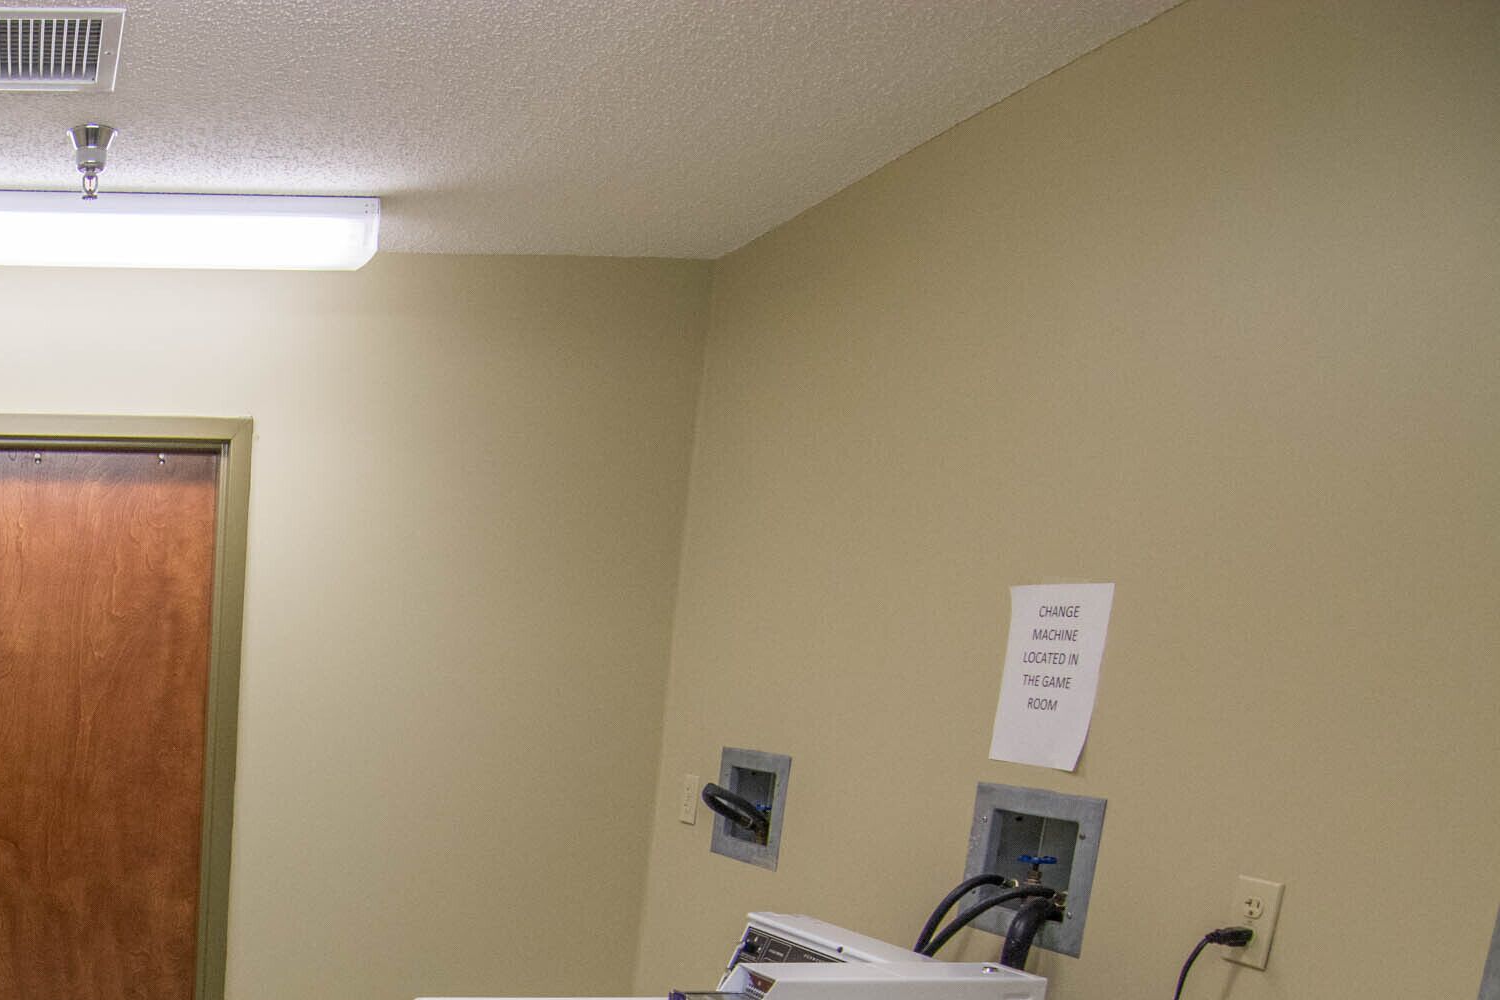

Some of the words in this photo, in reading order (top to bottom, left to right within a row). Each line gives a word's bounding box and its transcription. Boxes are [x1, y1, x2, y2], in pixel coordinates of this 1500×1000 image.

[1038, 605, 1080, 618] CHANGE
[1032, 628, 1079, 642] MACHINE
[1023, 651, 1066, 665] LOCATED
[1067, 653, 1079, 666] IN
[1022, 673, 1040, 687] THE
[1041, 675, 1071, 689] GAME
[1027, 697, 1058, 711] ROOM
